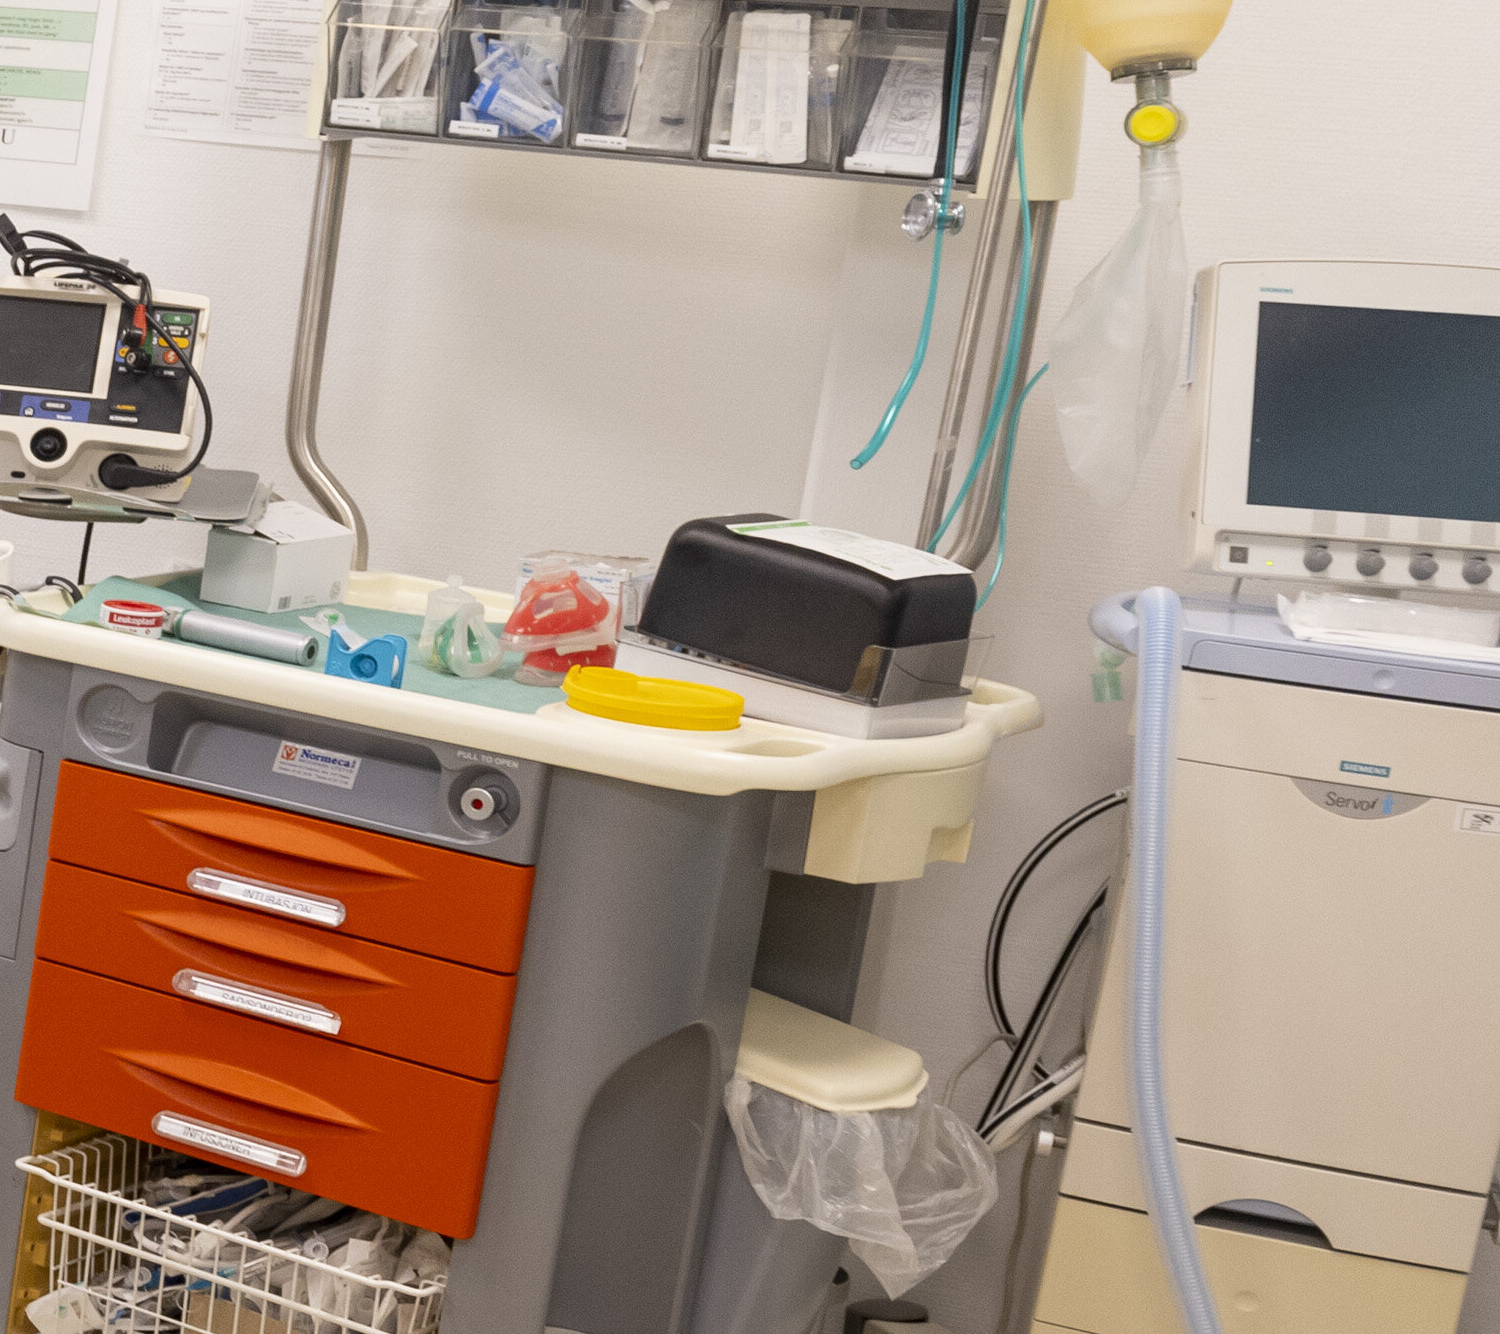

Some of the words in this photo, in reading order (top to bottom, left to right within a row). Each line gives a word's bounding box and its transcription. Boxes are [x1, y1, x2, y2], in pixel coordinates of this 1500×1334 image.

[113, 613, 157, 627] Leukoplast
[300, 748, 351, 769] Normeca
[456, 750, 478, 761] PULL
[481, 753, 493, 763] TO
[494, 756, 519, 768] OPEN
[1343, 762, 1389, 777] SIEMENS
[242, 887, 313, 915] INTUBASJON
